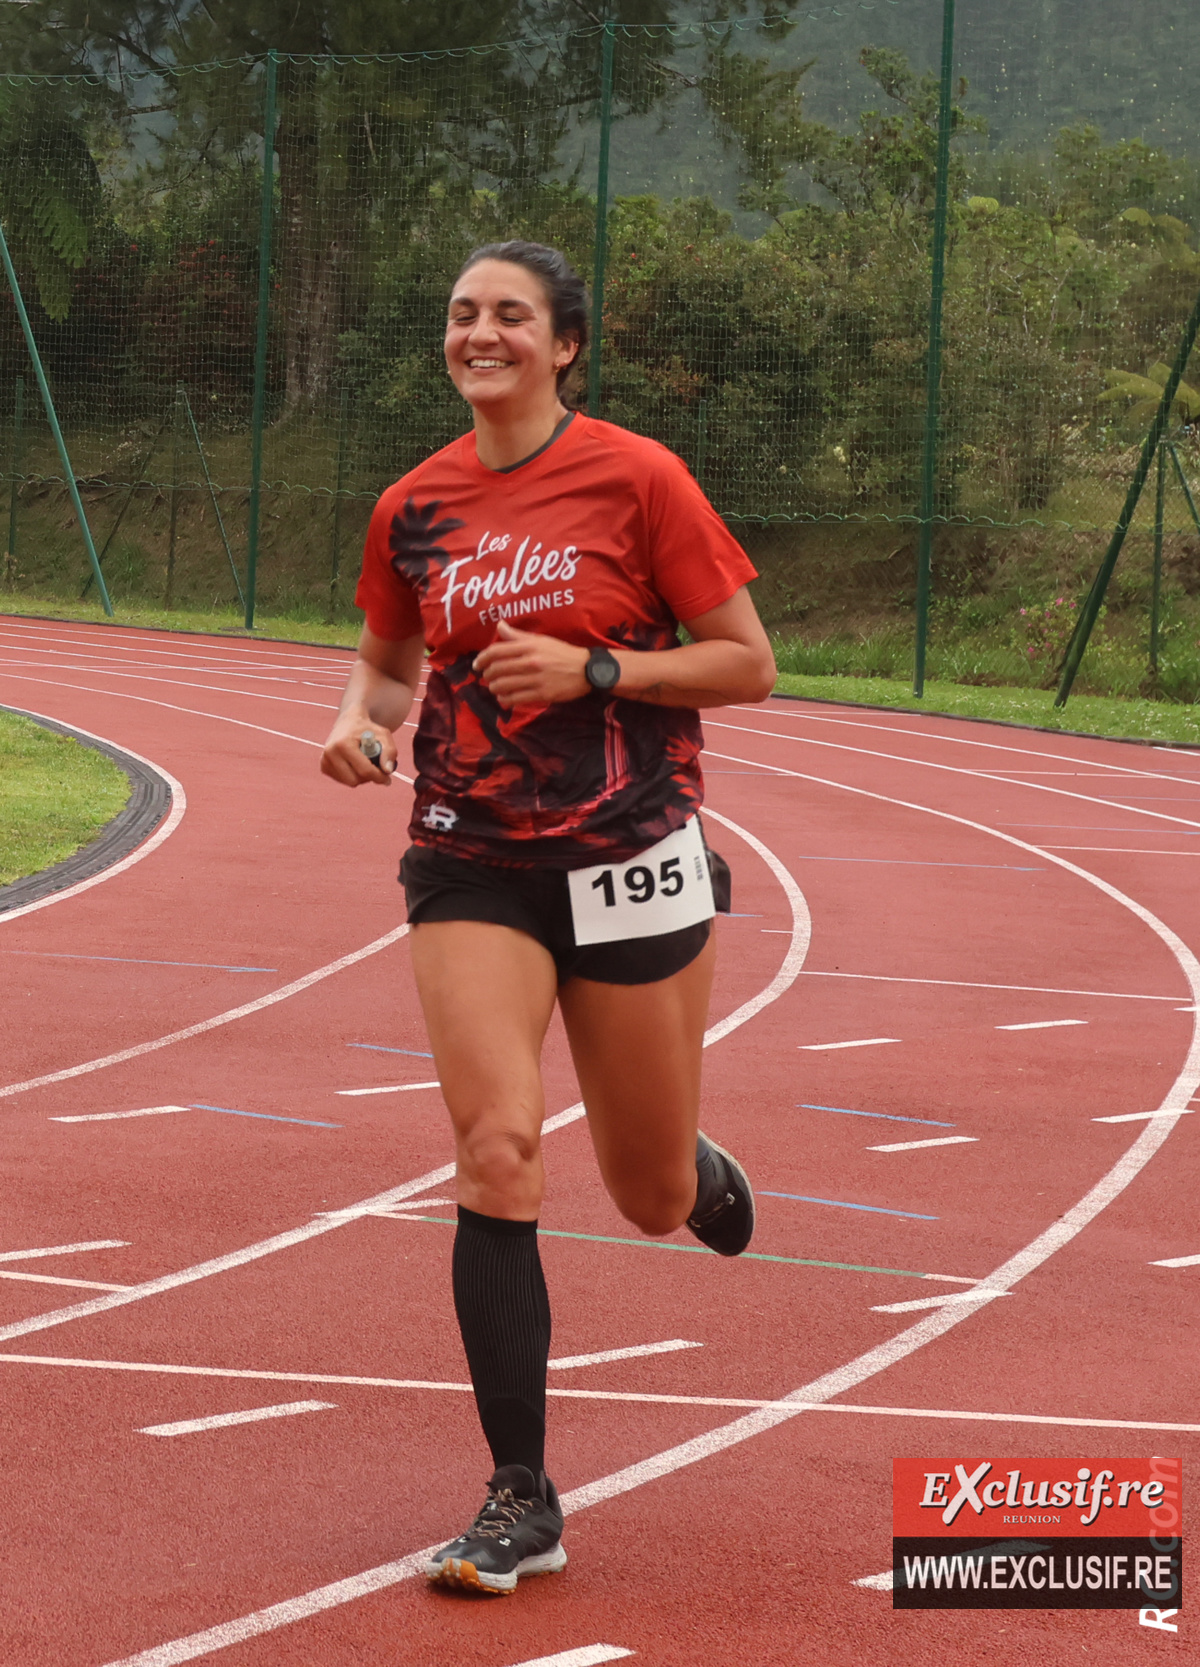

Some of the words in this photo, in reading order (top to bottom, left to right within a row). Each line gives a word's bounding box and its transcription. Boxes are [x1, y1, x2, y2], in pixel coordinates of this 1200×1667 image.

[476, 530, 512, 561] Les
[440, 535, 583, 634] Foulées
[478, 588, 575, 626] FÉMININES
[591, 856, 684, 908] 195
